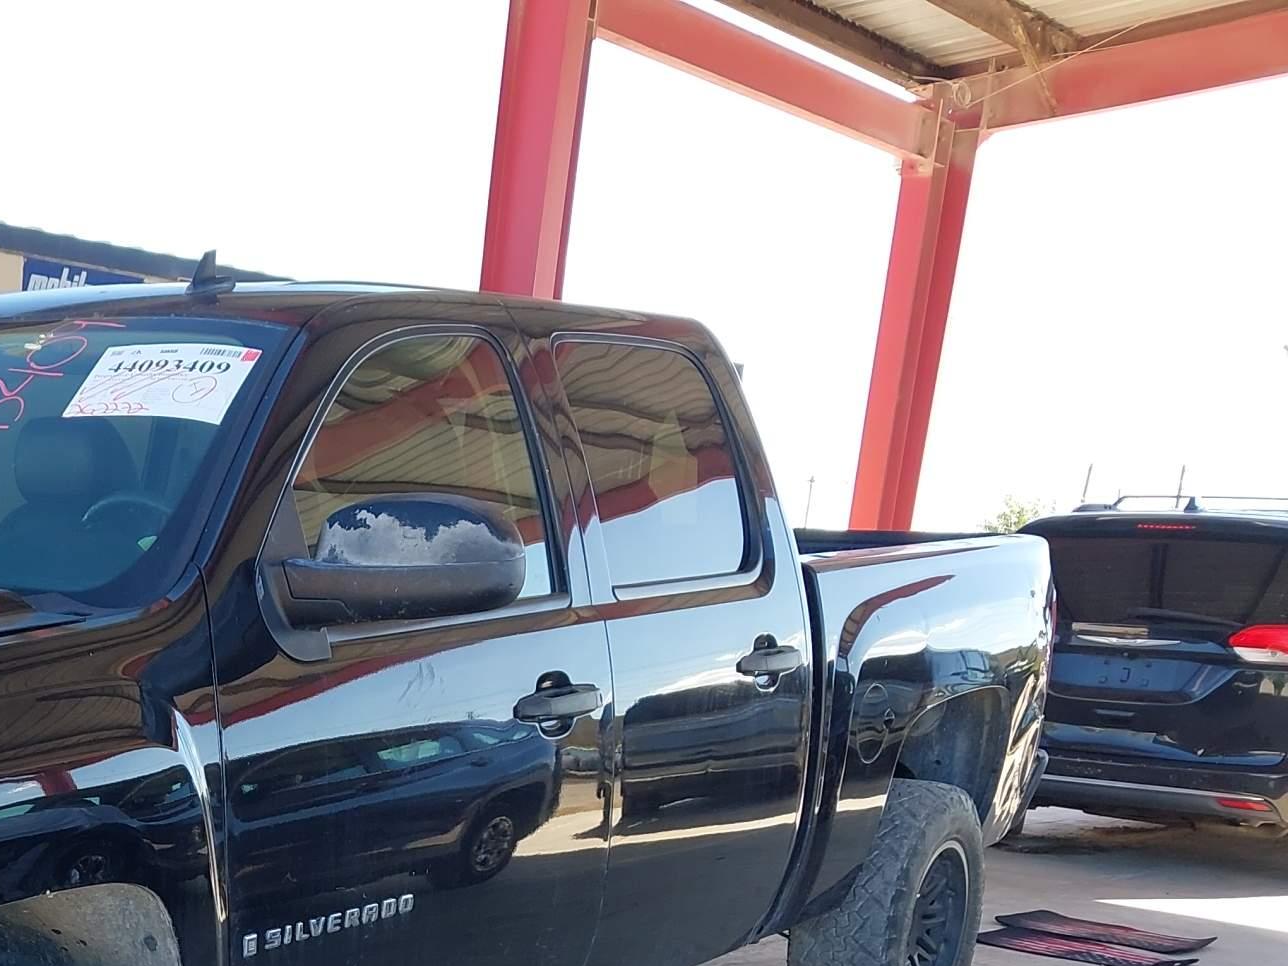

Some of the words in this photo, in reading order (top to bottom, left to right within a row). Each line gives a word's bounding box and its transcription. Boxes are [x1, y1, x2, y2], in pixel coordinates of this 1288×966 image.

[26, 266, 88, 292] mobil
[108, 358, 232, 376] 44093409
[264, 893, 415, 951] SILVERADO
